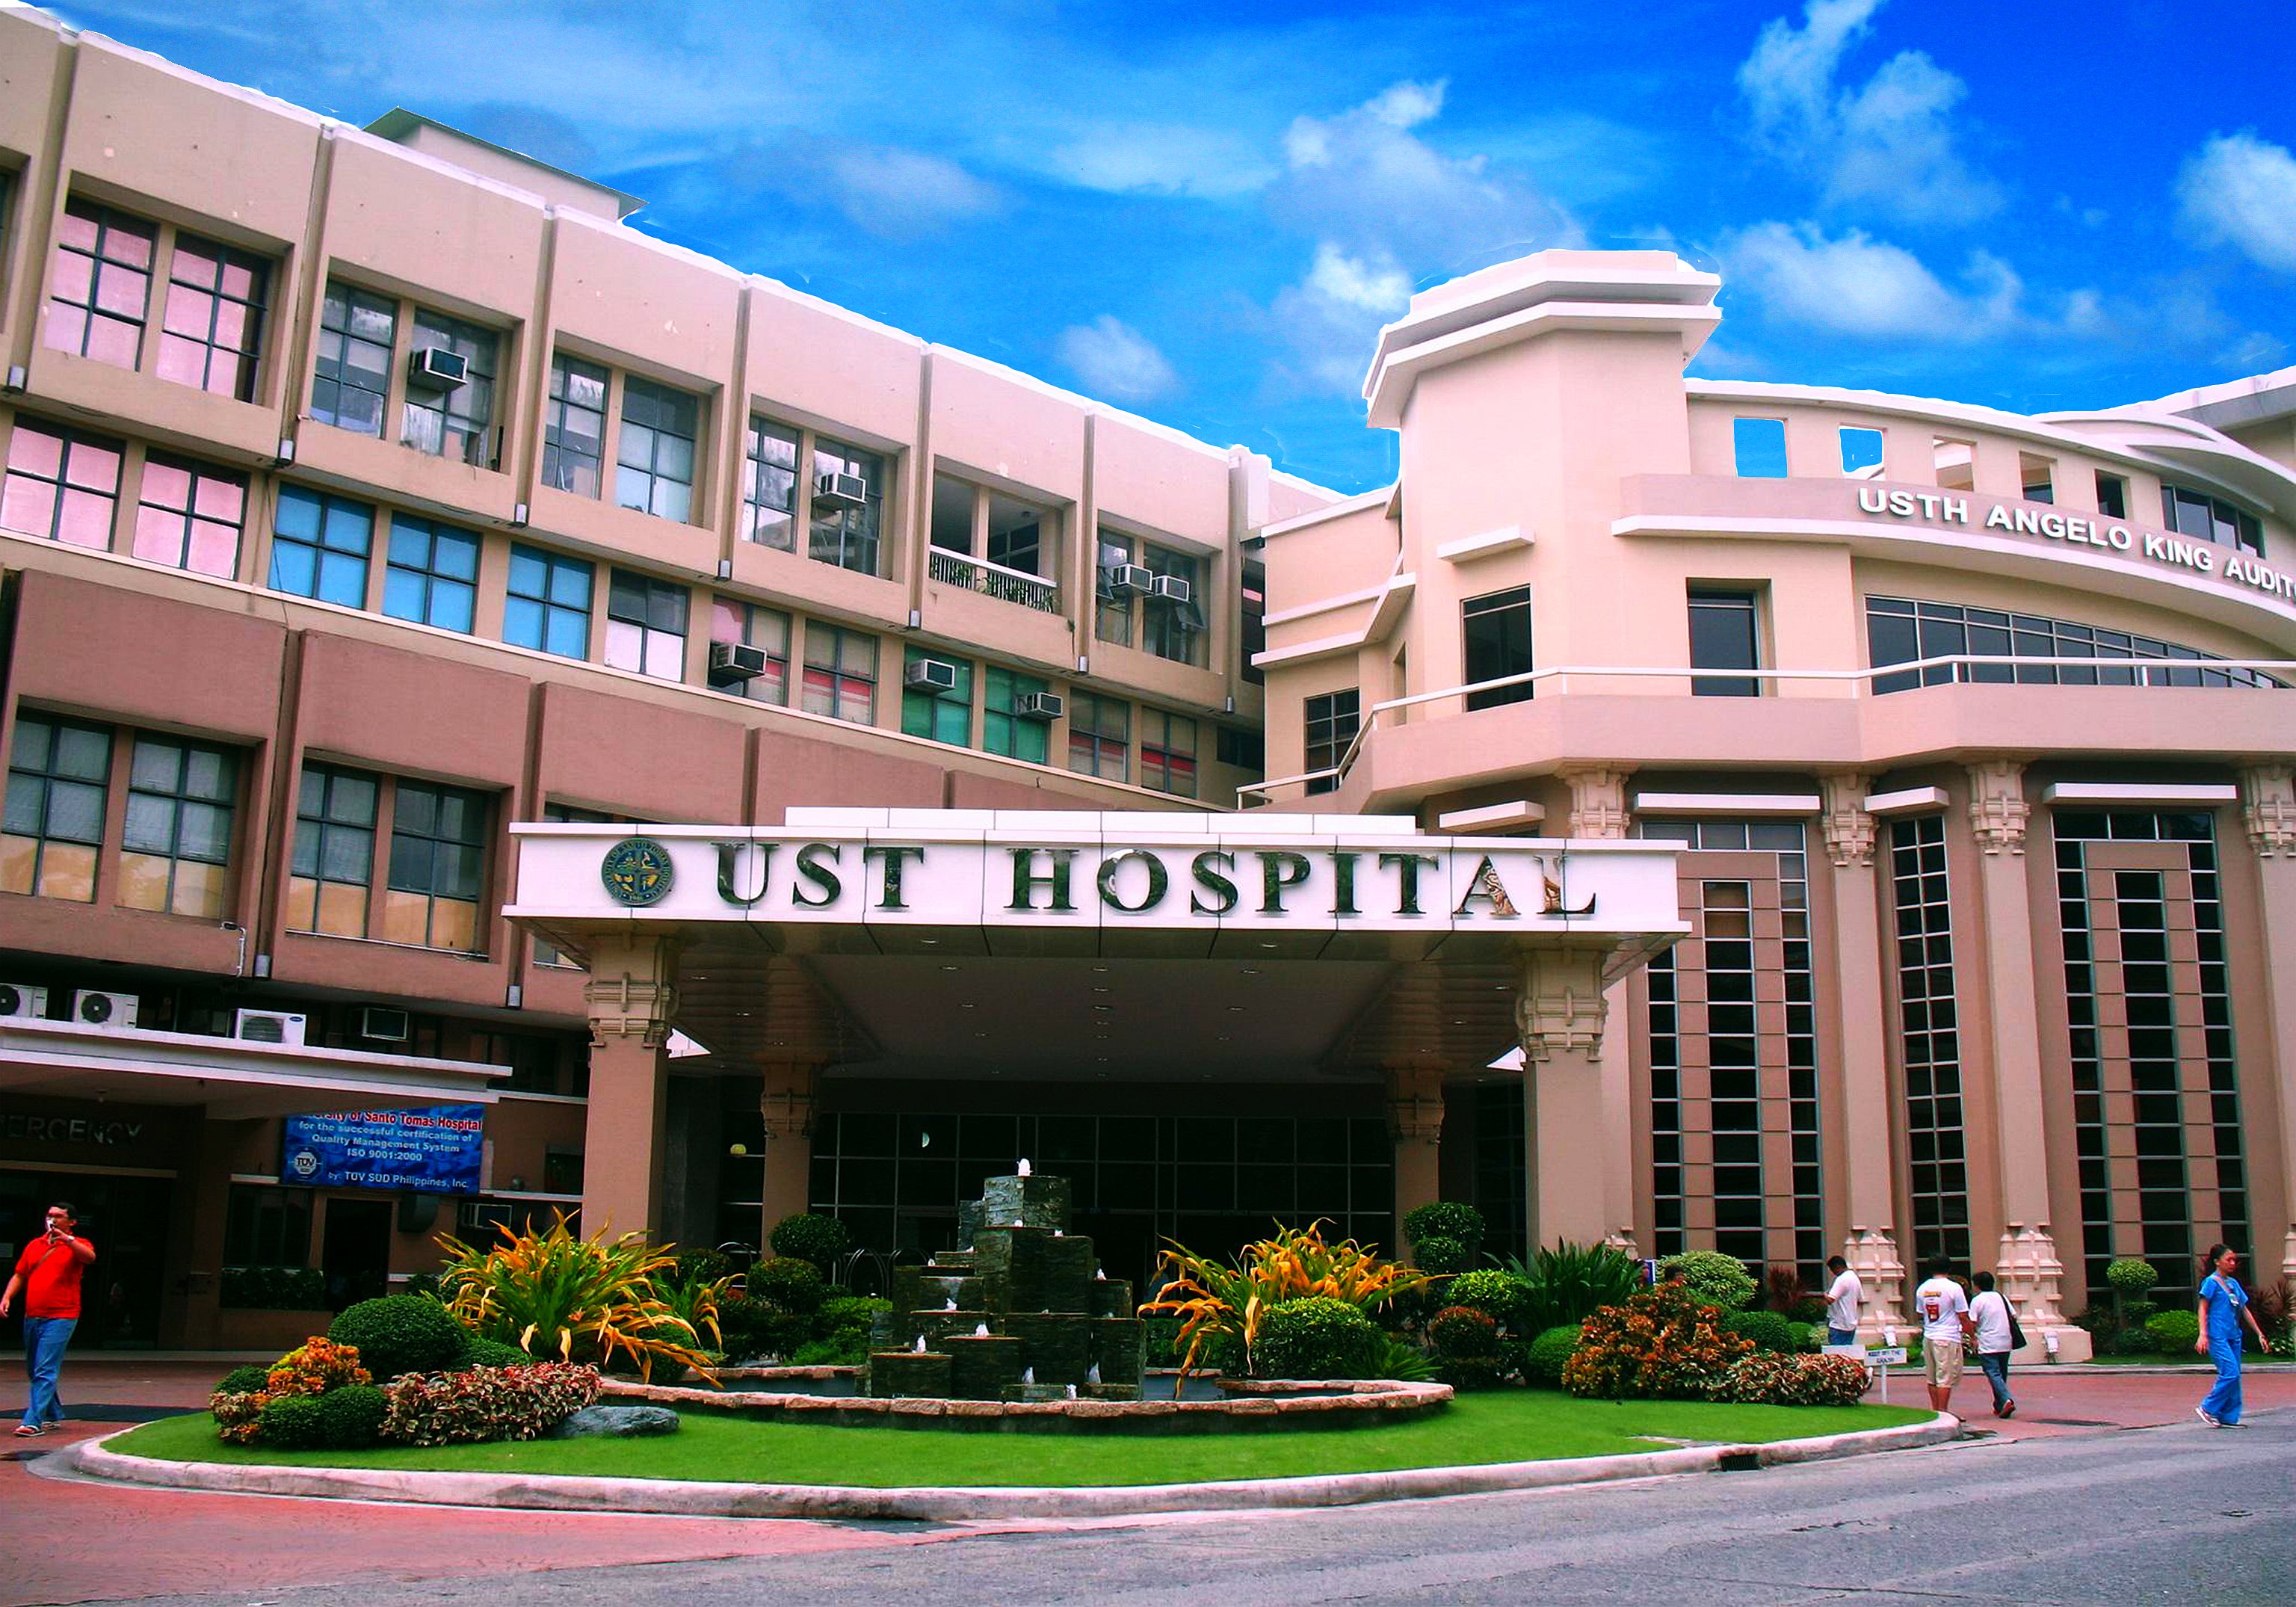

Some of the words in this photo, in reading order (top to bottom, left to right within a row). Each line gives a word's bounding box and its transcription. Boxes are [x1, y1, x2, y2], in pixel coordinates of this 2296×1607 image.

[1858, 487, 1969, 524] USTH
[1985, 505, 2132, 550] ANGELO
[2144, 533, 2214, 571] KING
[2225, 557, 2296, 599] AUDIT
[710, 842, 925, 908] UST
[1003, 848, 1596, 916] HOSPITAL
[300, 1121, 313, 1129] for
[317, 1123, 335, 1131] the
[338, 1126, 394, 1136] successful
[397, 1129, 459, 1141] certification
[364, 1110, 397, 1124] Santo
[399, 1112, 433, 1127] Tomas
[436, 1116, 482, 1132] Hospital
[312, 1134, 350, 1146] Quality
[353, 1137, 419, 1149] Management
[423, 1141, 460, 1152] System
[347, 1148, 365, 1157] ISO
[368, 1150, 422, 1162] 9001:2000
